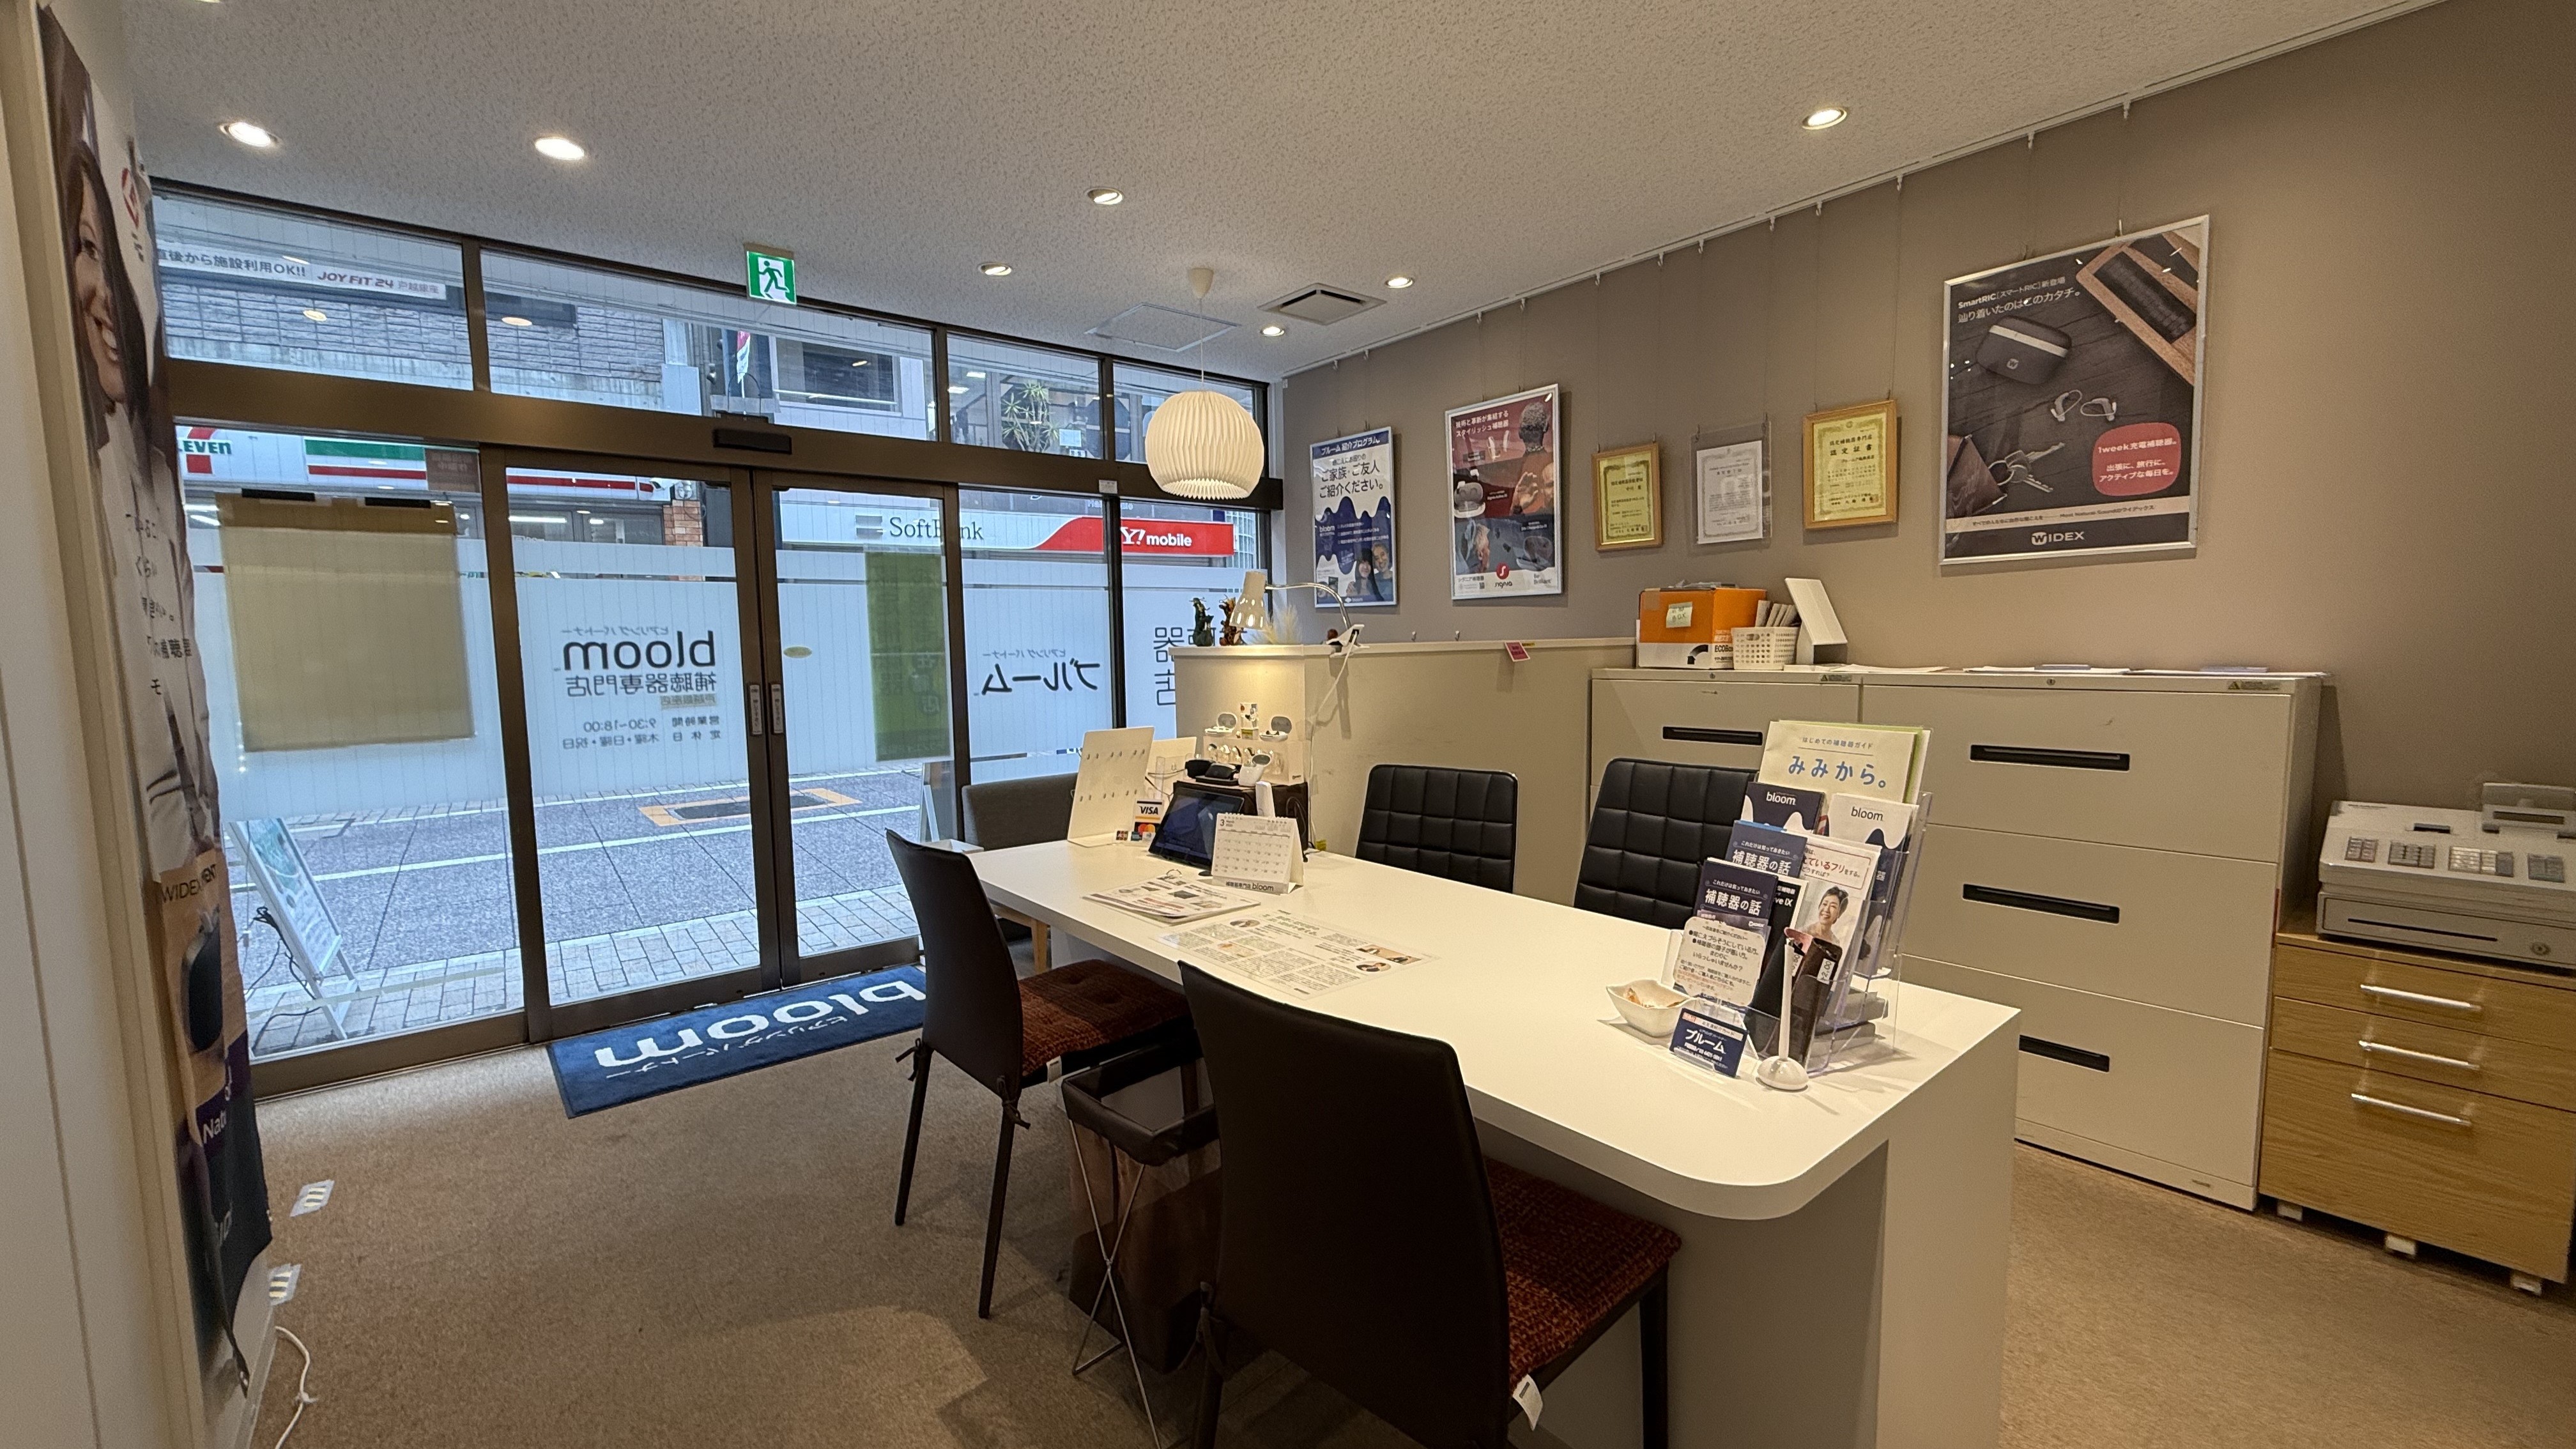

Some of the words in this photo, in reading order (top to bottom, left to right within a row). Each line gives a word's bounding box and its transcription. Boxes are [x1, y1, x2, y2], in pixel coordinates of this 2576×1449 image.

[1320, 479, 1383, 498] ご紹介ください。
[2031, 531, 2085, 546] WIDEX
[1802, 737, 1874, 749] はじめての補聴器ガイド
[1788, 755, 1886, 788] みみから。
[1766, 792, 1797, 806] bloom
[1139, 806, 1159, 815] VISA
[1851, 806, 1883, 821] bloom
[1732, 849, 1791, 876] 補聴器の話
[1252, 882, 1274, 892] bloom
[1705, 888, 1762, 916] 補聴器の話
[595, 981, 926, 1068] bloom
[1685, 1028, 1726, 1054] ブルーム
